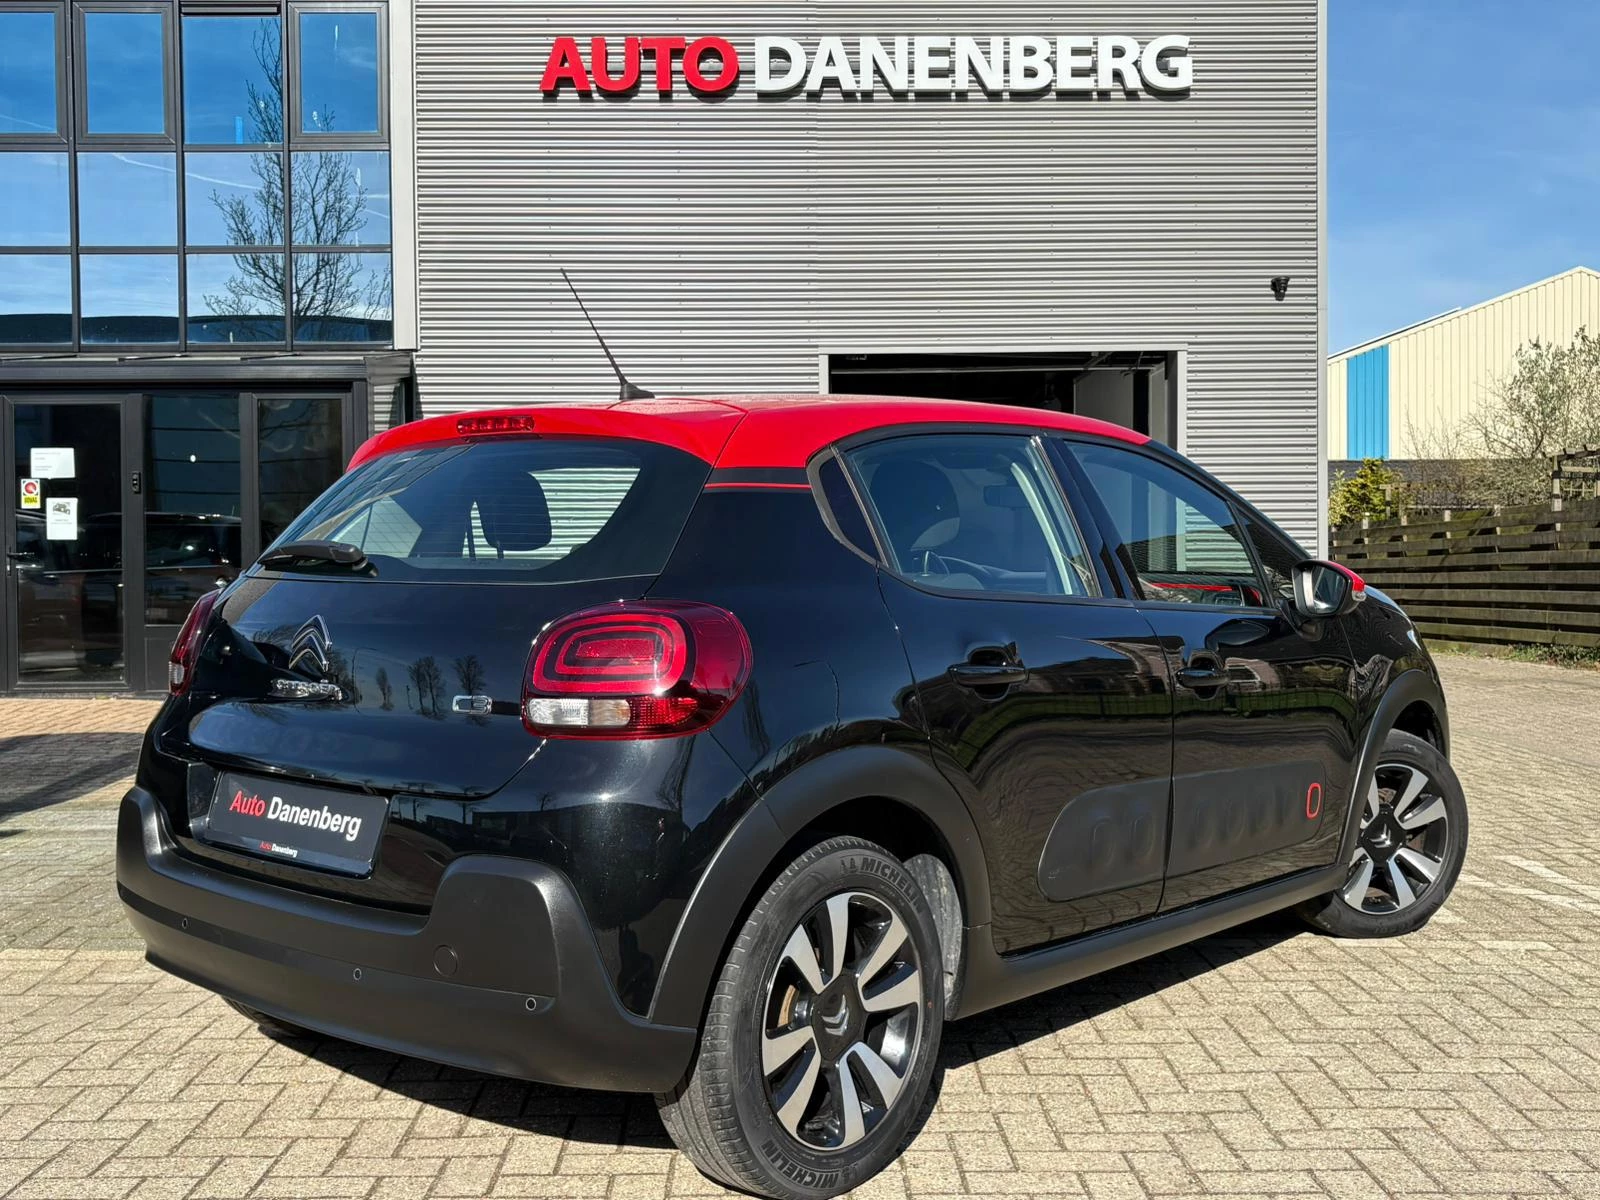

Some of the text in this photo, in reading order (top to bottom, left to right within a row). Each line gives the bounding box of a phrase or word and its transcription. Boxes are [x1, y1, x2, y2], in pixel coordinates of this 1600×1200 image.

[539, 35, 1194, 93] AUTO DANENBERG
[452, 695, 493, 715] C3
[229, 790, 362, 842] Auto Danenberg
[271, 843, 299, 858] Danenberg
[860, 857, 924, 914] MICHELIN
[761, 1139, 838, 1187] MICHELIN
